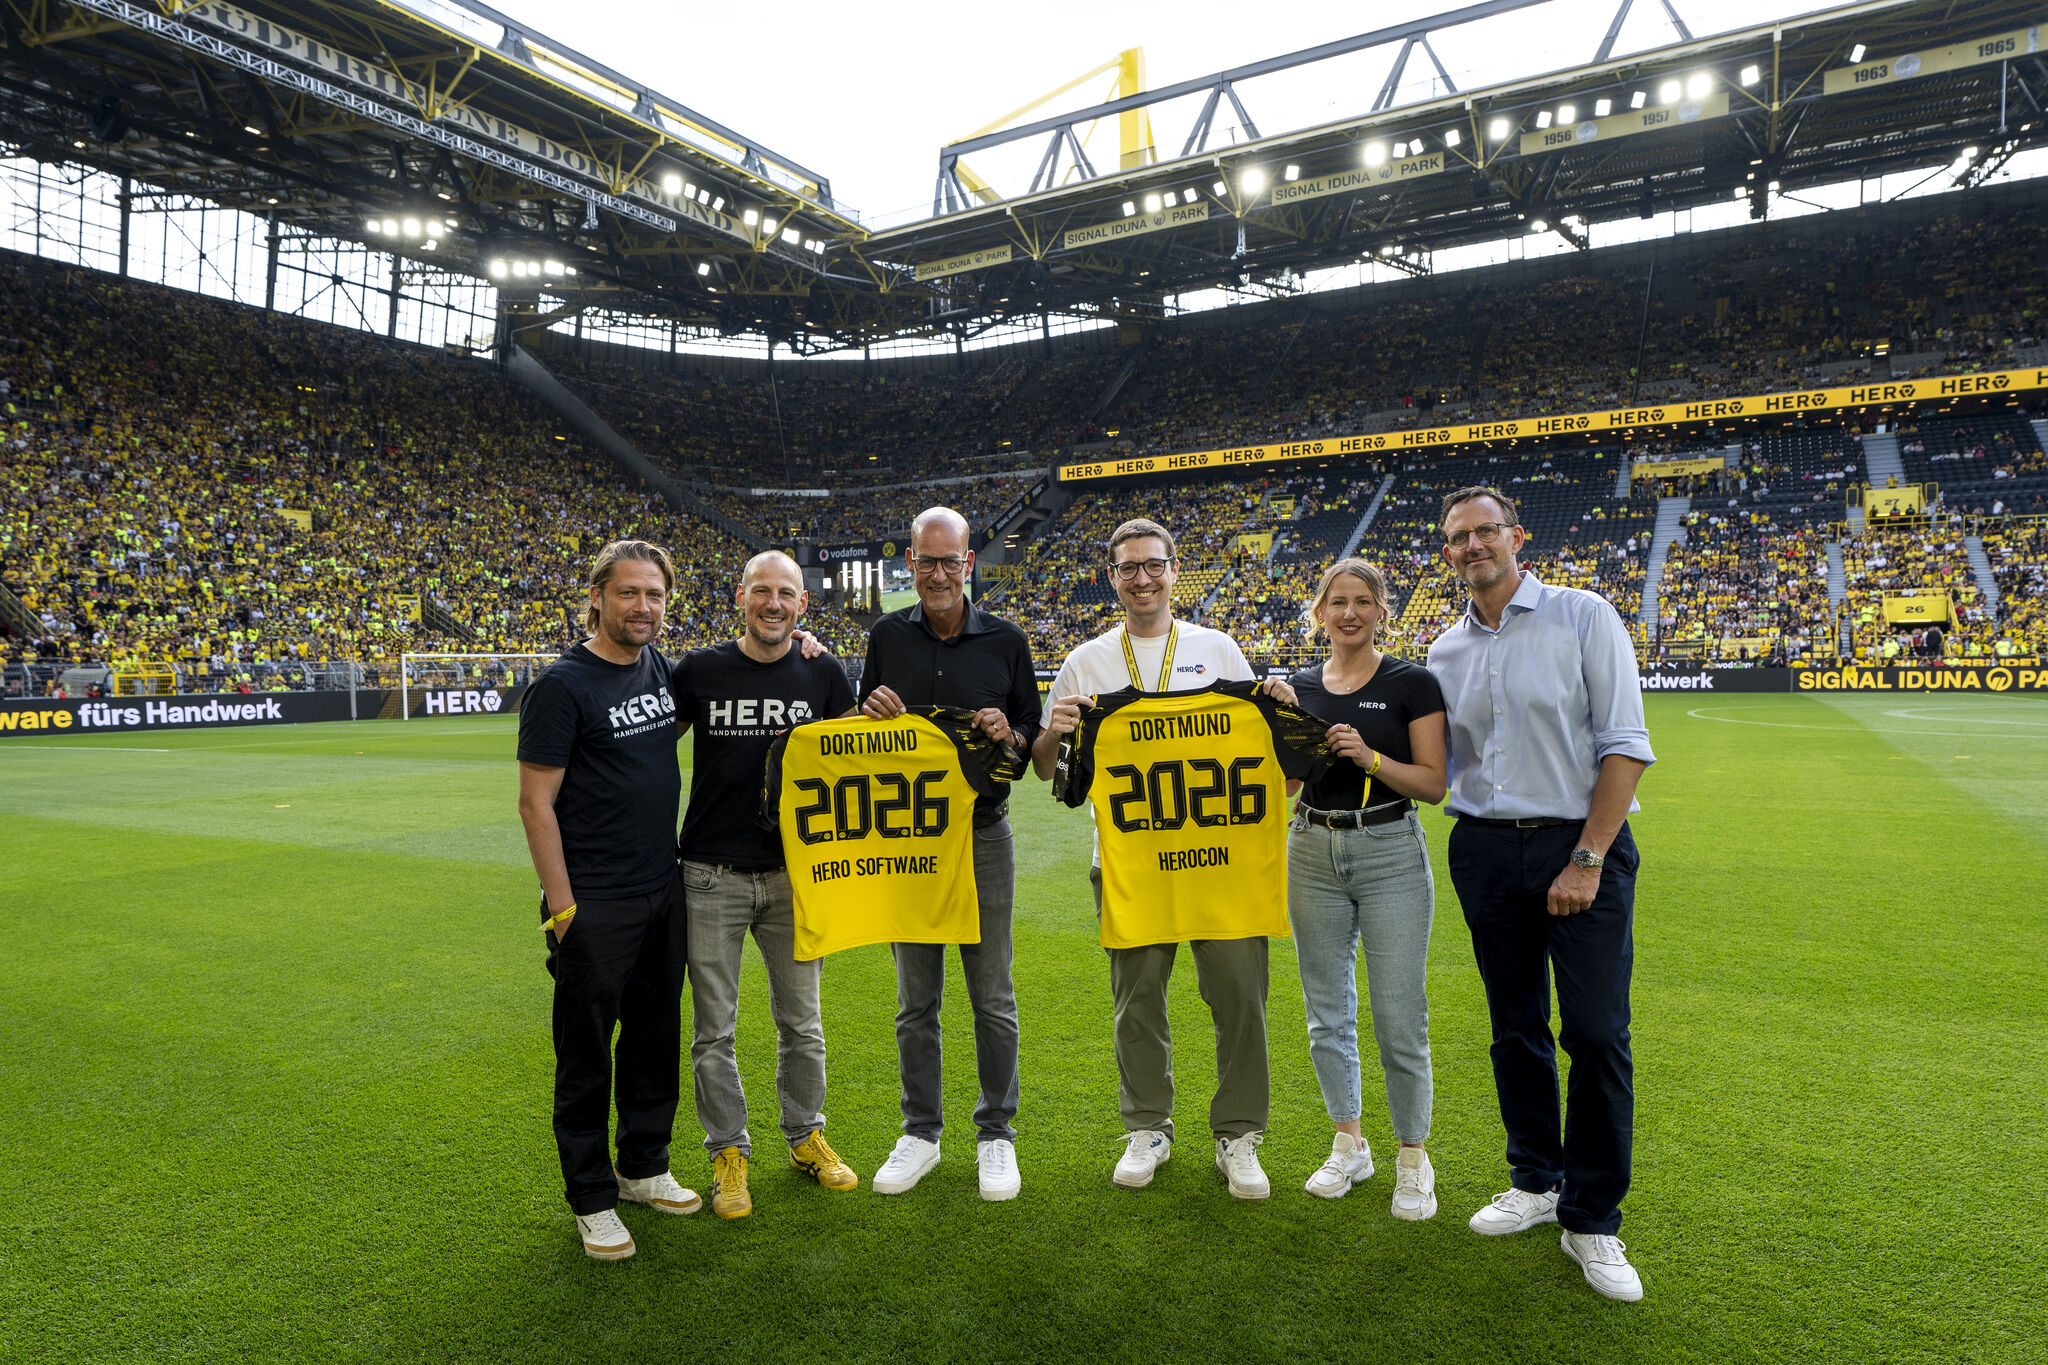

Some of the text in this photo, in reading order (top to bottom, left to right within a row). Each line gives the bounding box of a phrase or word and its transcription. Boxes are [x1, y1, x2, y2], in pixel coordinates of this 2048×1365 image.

[1853, 37, 2016, 83] 1963 1965
[1543, 110, 1670, 146] 1956 1957
[1275, 157, 1440, 200] SIGNAL IDUNA PARK
[1067, 206, 1205, 245] SIGNAL IDUNA PARK
[918, 249, 1008, 276] SIGNAL IDUNA PARK
[1884, 498, 1900, 506] 27
[830, 547, 868, 559] vodafone
[1905, 605, 1925, 614] 26
[1799, 671, 1892, 689] SIGNAL
[1898, 671, 1982, 689] IDUNA
[78, 703, 141, 727] fürs
[145, 698, 282, 724] Handwerk
[1359, 701, 1387, 710] HERO
[613, 723, 657, 739] HANDWERKER
[1129, 713, 1231, 742] DORTMUND
[820, 729, 918, 756] DORTMUND
[793, 770, 949, 845] 2026
[1106, 757, 1266, 833] 2026
[812, 856, 938, 884] HERO SOFTWARE
[1158, 847, 1229, 871] HEROCON
